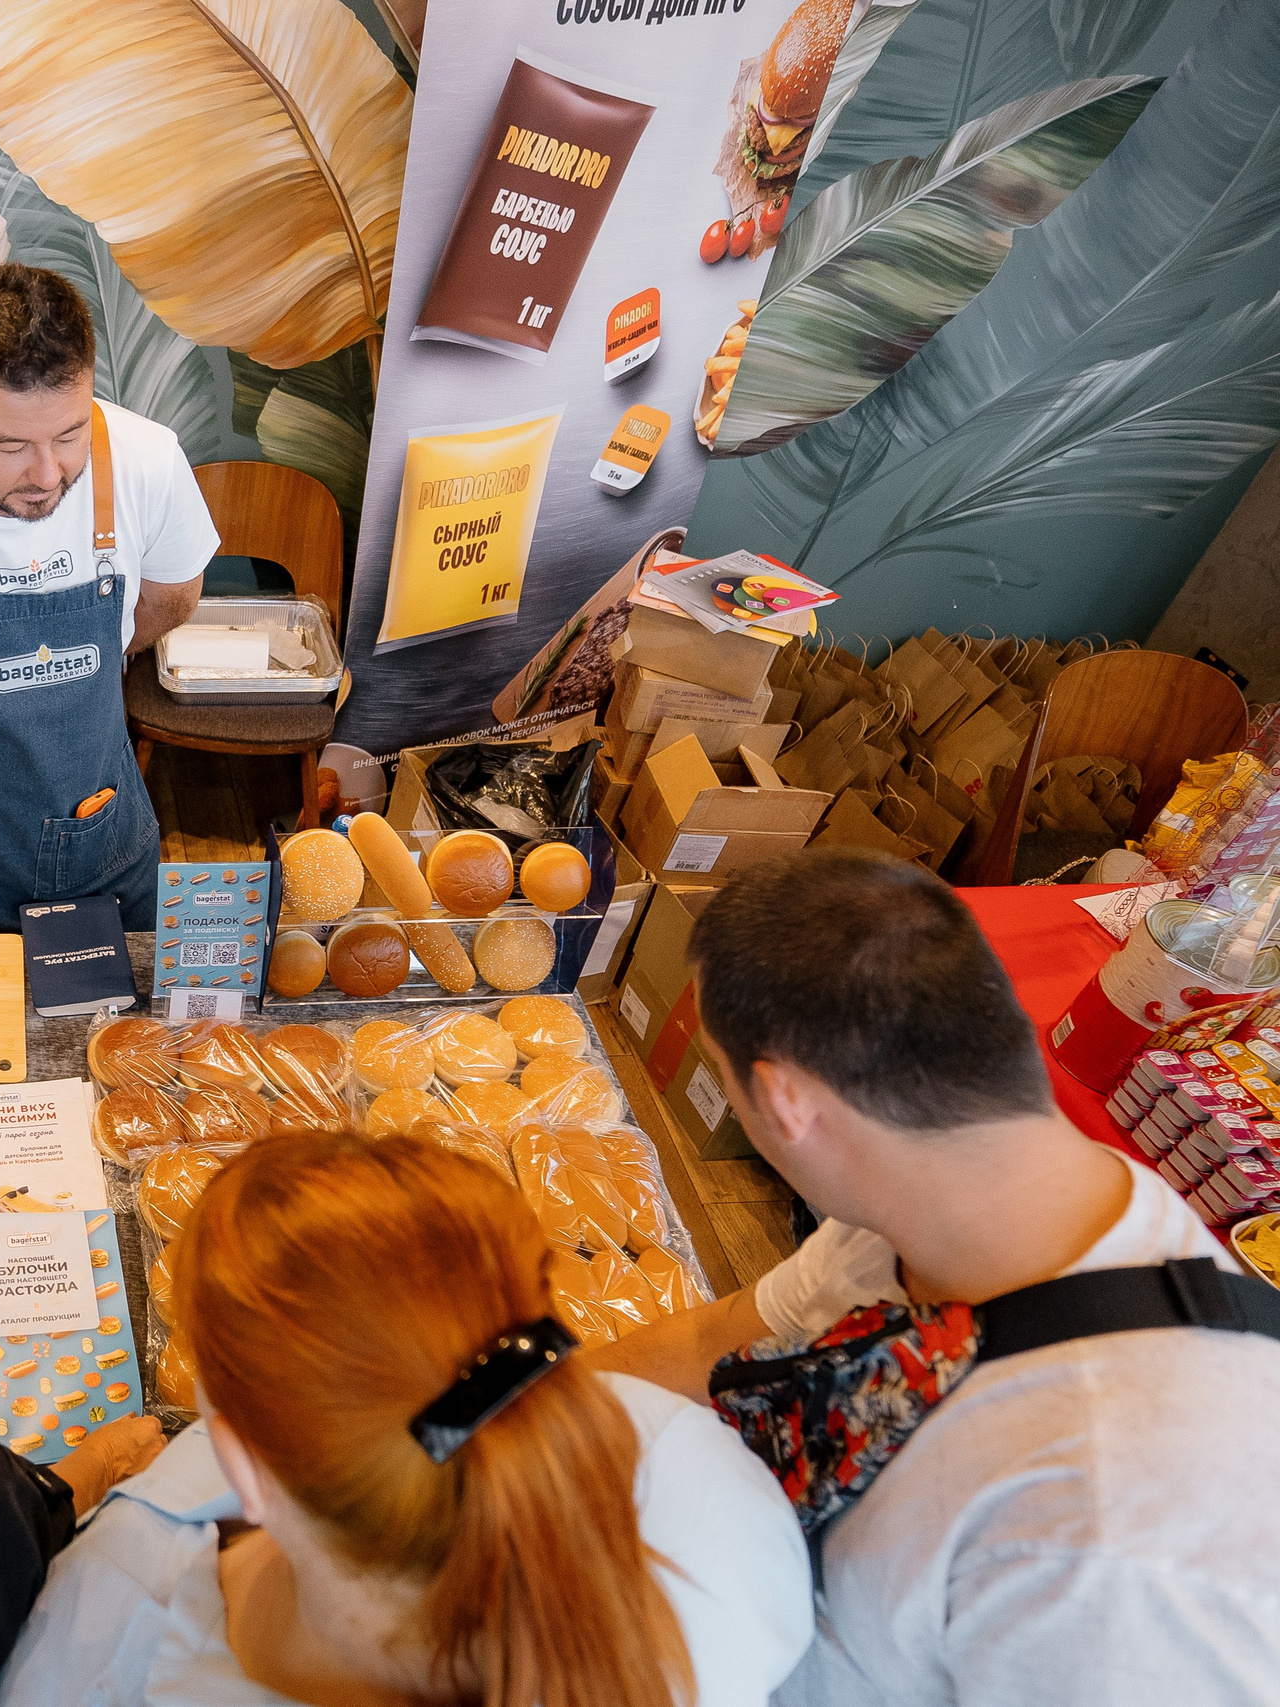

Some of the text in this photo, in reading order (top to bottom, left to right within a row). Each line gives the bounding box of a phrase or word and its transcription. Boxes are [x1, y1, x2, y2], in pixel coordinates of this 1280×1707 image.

[497, 125, 611, 189] PIKADOR PRO
[490, 223, 547, 265] СОУС
[517, 296, 534, 324] 1
[614, 301, 653, 332] PIKADOR
[622, 417, 662, 444] PIKADOR
[418, 464, 531, 510] PIKADOR PRO
[433, 511, 502, 545] СЫРНЫЙ
[438, 540, 488, 572] СОУС
[480, 583, 490, 605] 1
[35, 666, 93, 683] FOODSERVICE
[352, 753, 403, 770] ВНЕШНИ
[492, 718, 532, 735] МОЖЕТ
[531, 700, 596, 726] ОТЛИЧАТЬСЯ
[196, 894, 231, 904] bagerstat
[184, 917, 239, 926] ПОДАРОК
[195, 926, 240, 934] подписку!
[64, 950, 116, 963] БАГЕРСТАТ
[20, 1102, 55, 1113] ВКУС
[5, 1131, 26, 1140] парой
[29, 1130, 54, 1139] сезона
[11, 1236, 47, 1244] bagerstat
[8, 1255, 55, 1263] НАСТОЯЩИЕ
[17, 1274, 68, 1283] НАСТОЯЩЕГО
[32, 1313, 81, 1322] ПРОДУКЦИИ
